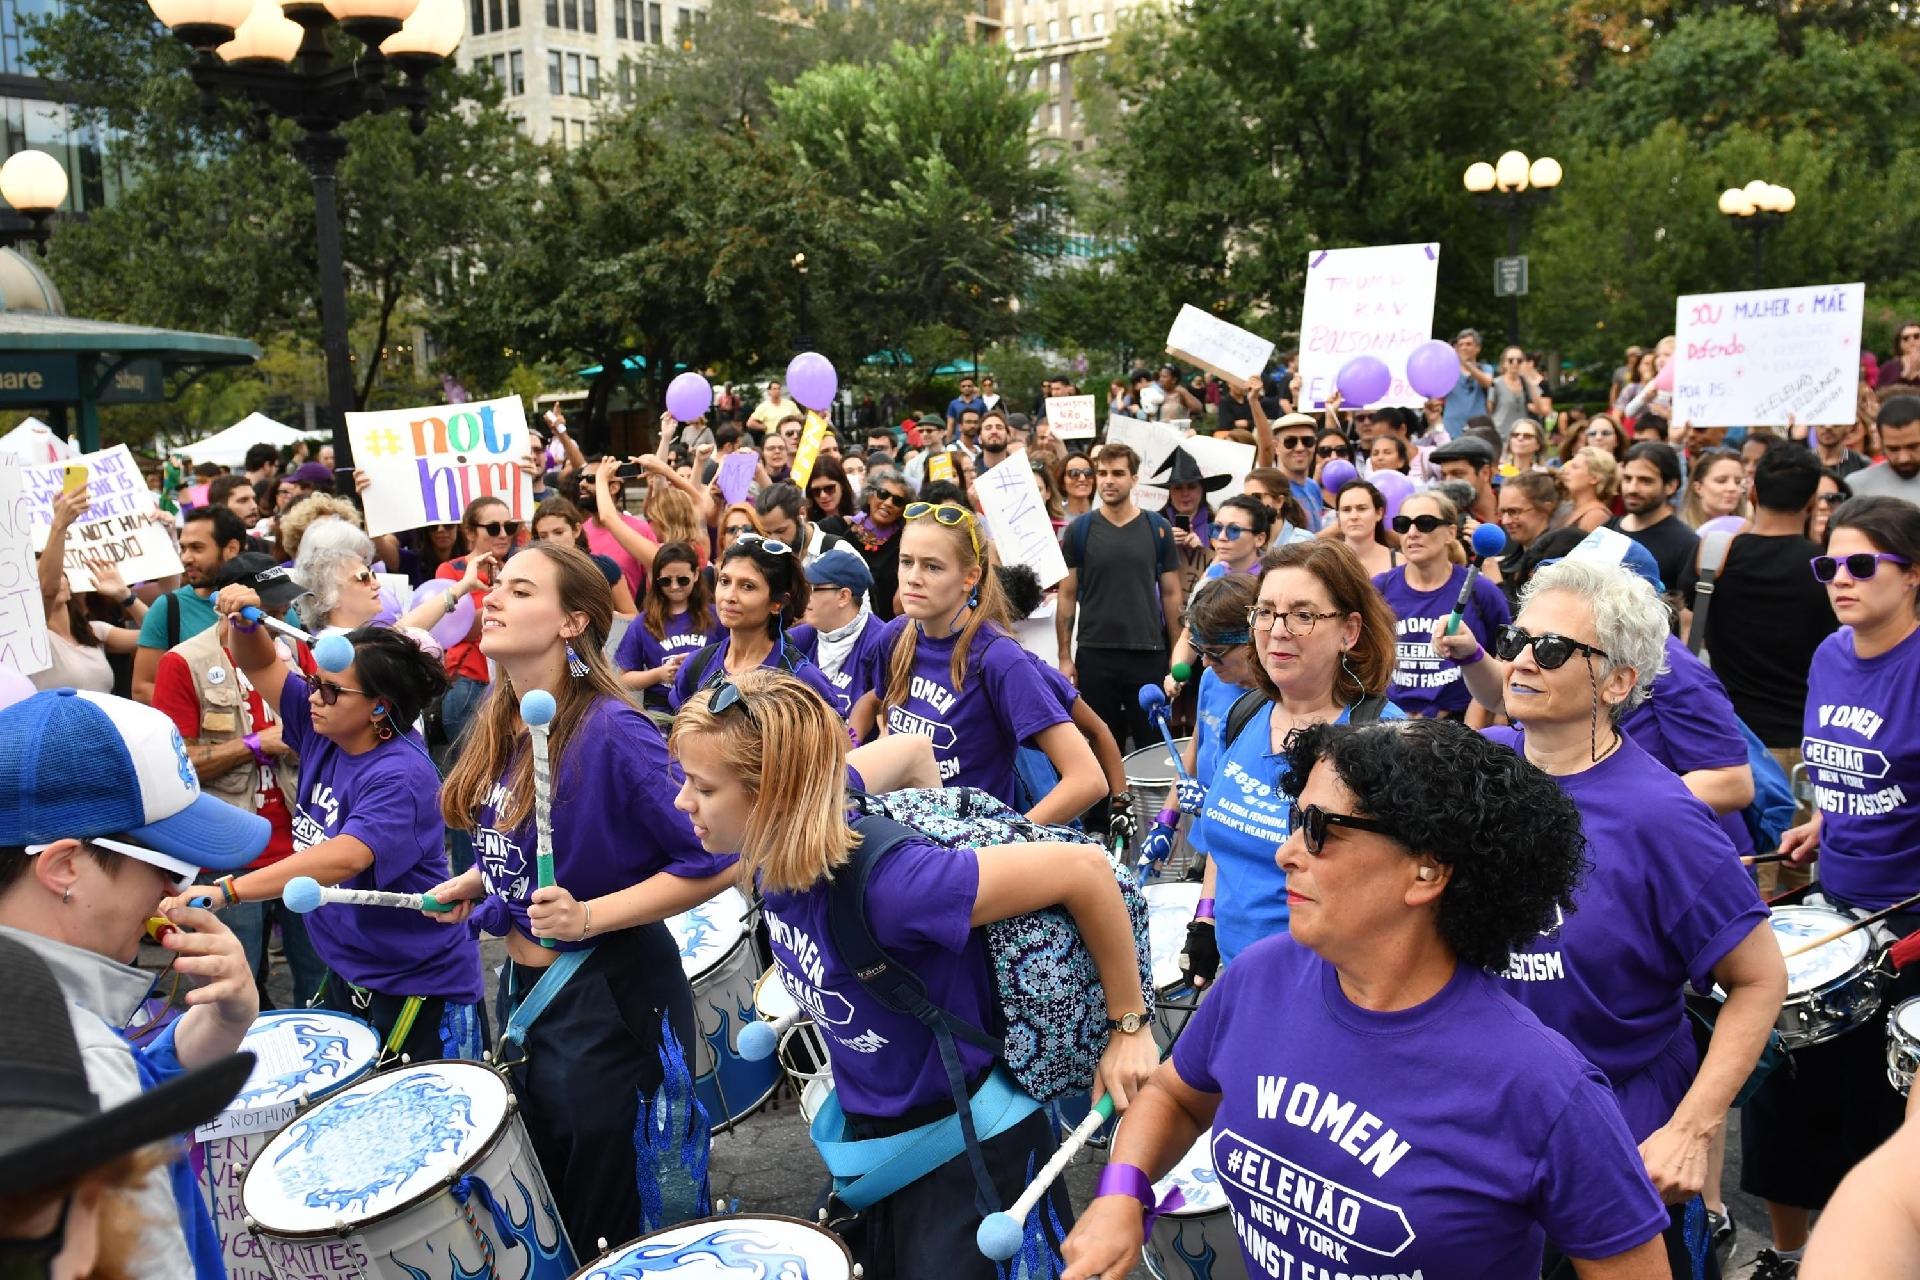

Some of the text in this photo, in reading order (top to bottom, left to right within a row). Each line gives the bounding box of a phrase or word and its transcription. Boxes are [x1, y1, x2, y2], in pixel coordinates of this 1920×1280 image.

[1734, 297, 1791, 320] MULHER
[0, 371, 44, 390] are
[410, 406, 511, 456] not
[415, 455, 523, 523] him
[659, 634, 708, 651] WOMEN
[910, 676, 956, 715] OMEN
[1818, 704, 1885, 741] WOMEN
[1818, 768, 1866, 789] NEW YORK
[1218, 797, 1250, 818] BATERIA
[1248, 811, 1287, 829] FEMININA
[1814, 784, 1908, 816] INST FASCISM
[1206, 807, 1289, 843] GOTHAM'S HEARTBEA
[764, 909, 825, 989] WOMEN
[1501, 950, 1565, 982] SCISM
[230, 1107, 293, 1128] NOTHIM
[1256, 1075, 1412, 1179] WOMEN
[1227, 1148, 1362, 1236] #ELENÃO
[1227, 1200, 1295, 1280] AINST
[1250, 1199, 1349, 1265] NEW YORK
